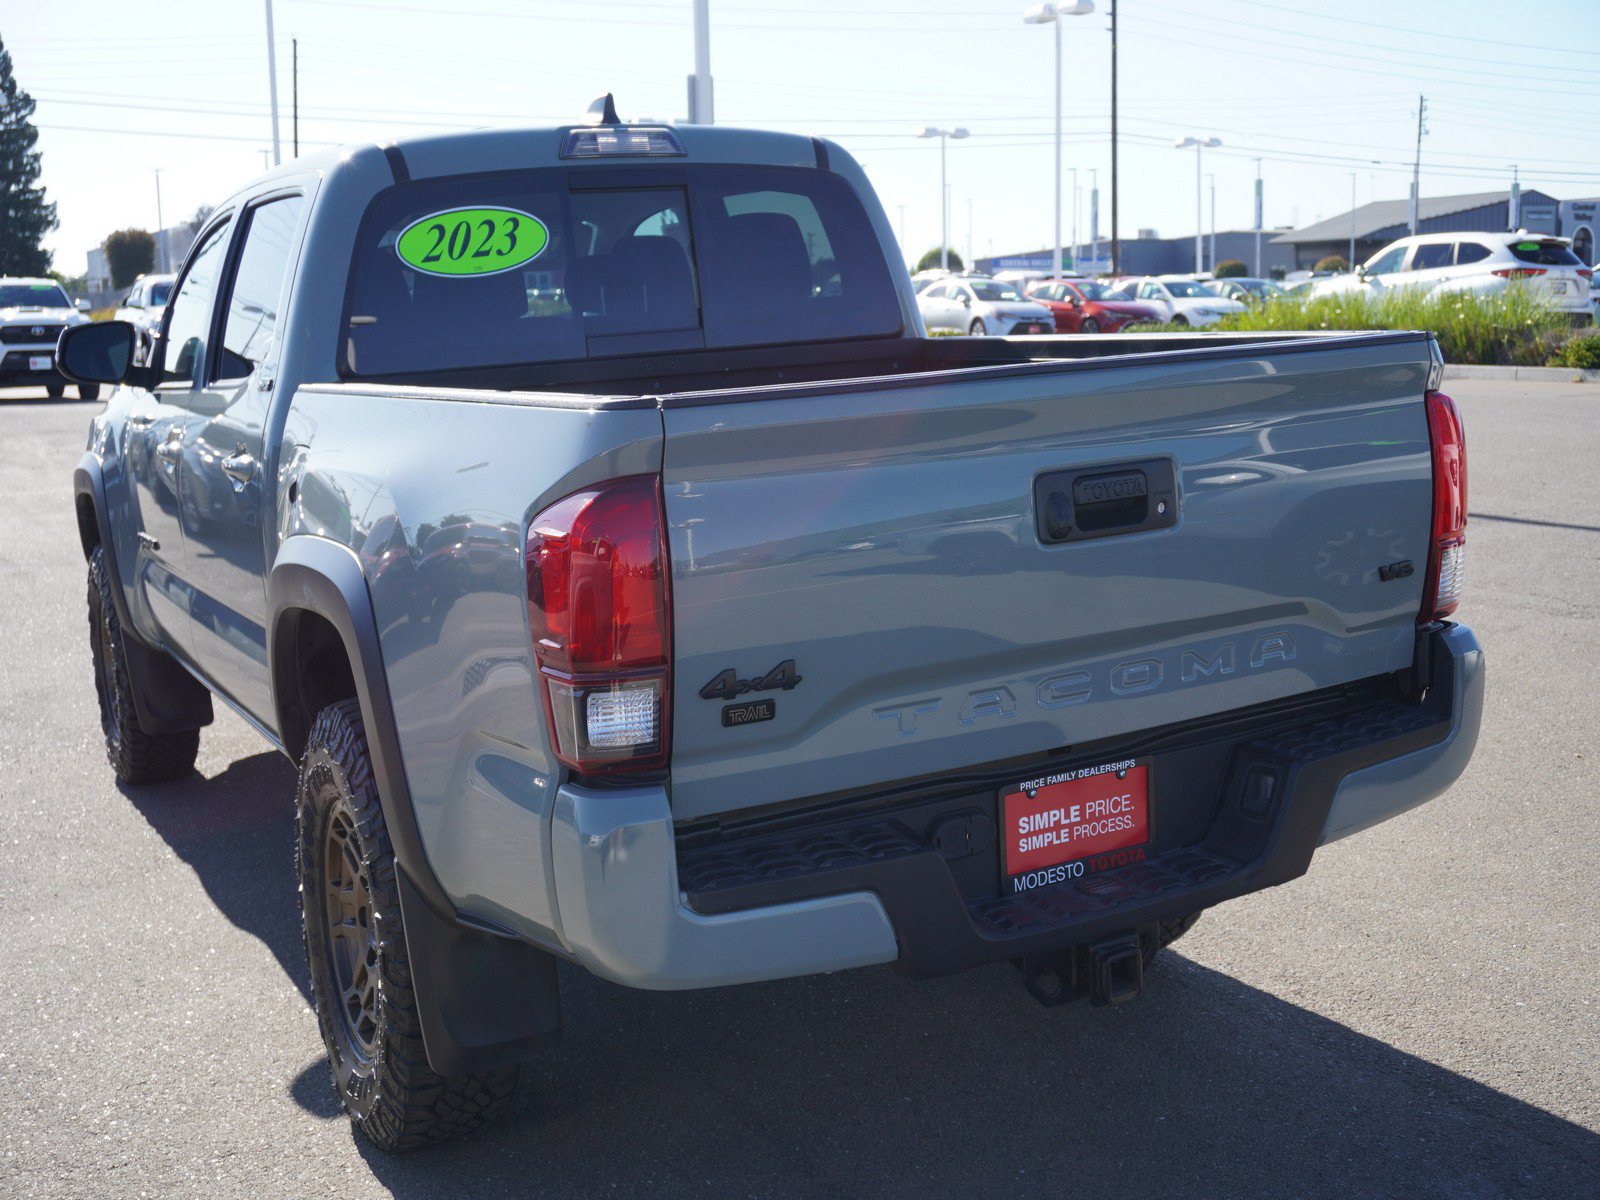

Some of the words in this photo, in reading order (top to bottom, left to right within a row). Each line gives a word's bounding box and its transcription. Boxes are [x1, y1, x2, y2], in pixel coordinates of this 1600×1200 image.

[421, 216, 520, 263] 2023
[1083, 477, 1145, 502] TOYOTA
[872, 631, 1298, 737] TACOMA
[728, 704, 772, 723] TRAIL
[1020, 779, 1045, 792] PRICE
[1047, 770, 1077, 786] FAMILY
[1078, 758, 1136, 779] DEALERSHIPS
[1018, 804, 1081, 835] SIMPLE
[1085, 794, 1135, 820] PRICE.
[1018, 828, 1070, 854] SIMPLE
[1073, 815, 1136, 841] PROCESS.
[1014, 861, 1084, 893] MODESTO
[1088, 847, 1146, 874] TOYOTA
